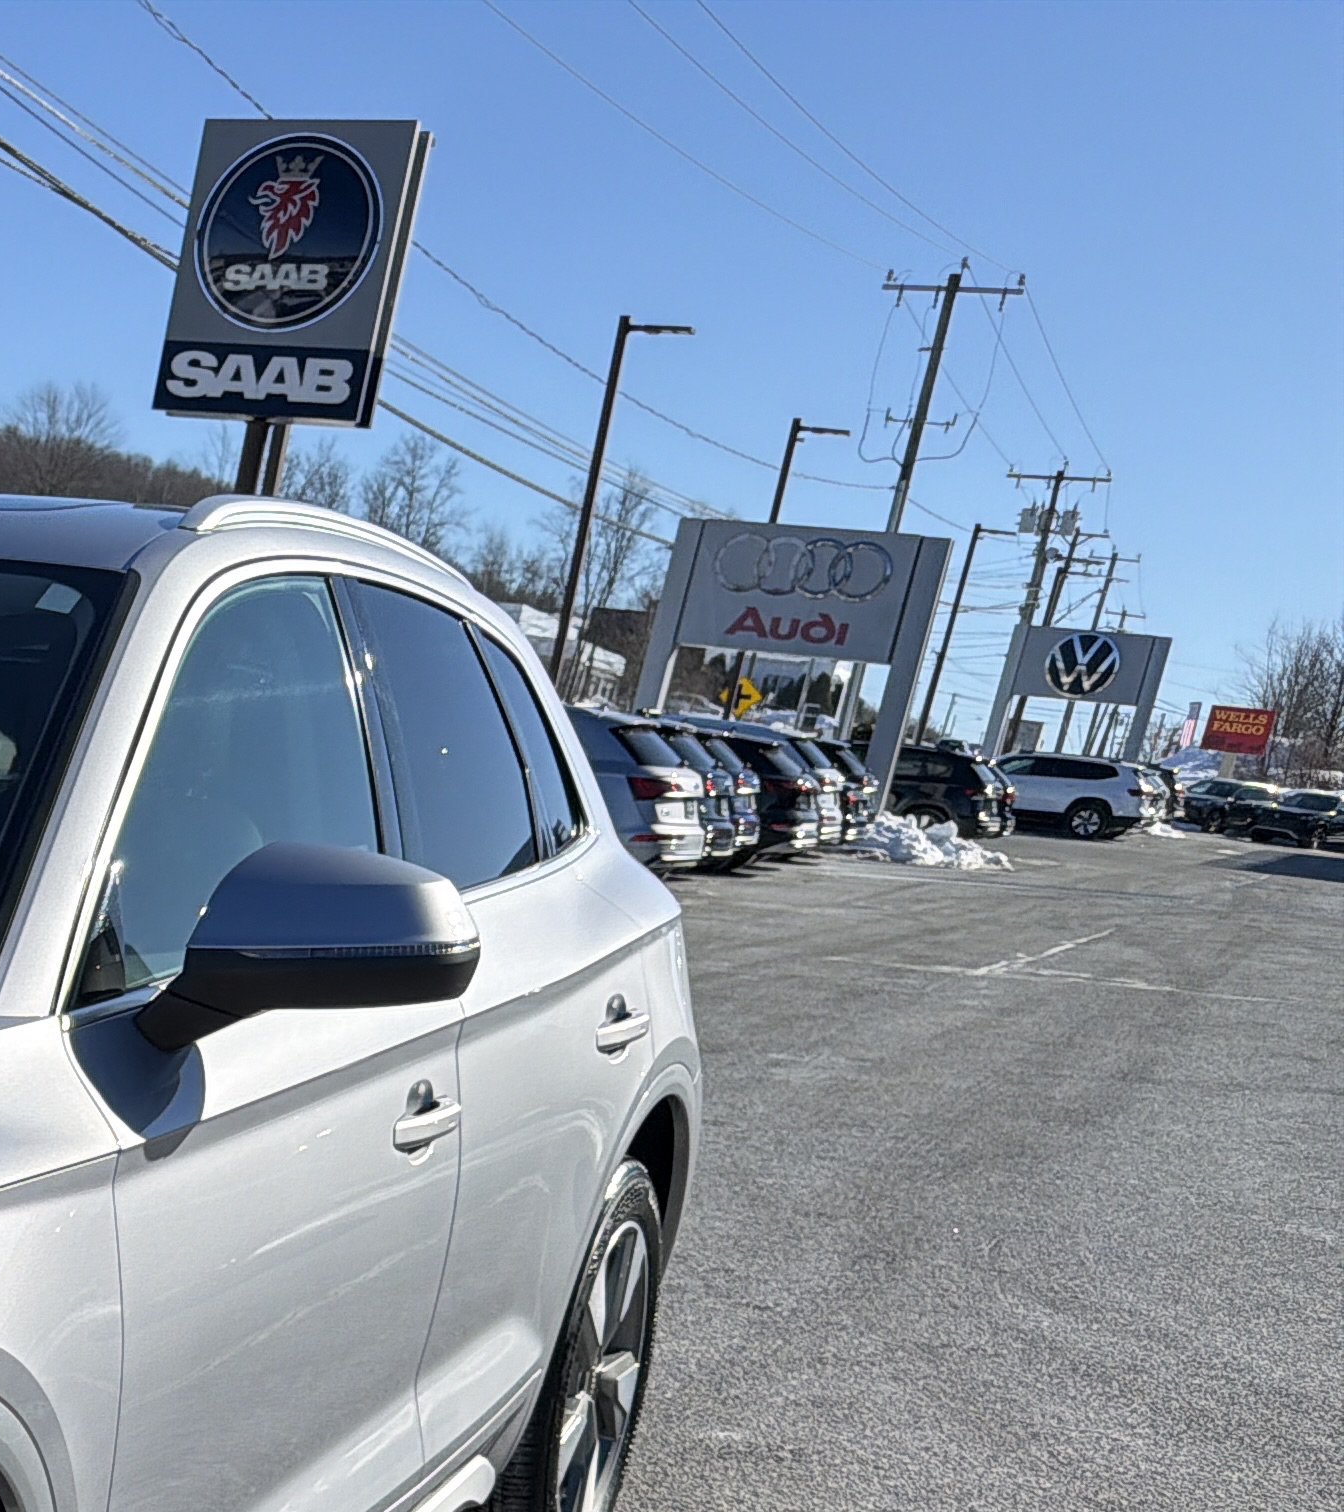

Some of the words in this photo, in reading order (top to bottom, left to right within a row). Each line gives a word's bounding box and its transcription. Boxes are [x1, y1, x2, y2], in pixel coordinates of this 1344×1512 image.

[223, 263, 329, 291] SAAB
[166, 350, 354, 405] SAAB
[723, 606, 850, 646] Audi
[1211, 720, 1265, 736] FARGO
[1214, 709, 1268, 725] WELLS
